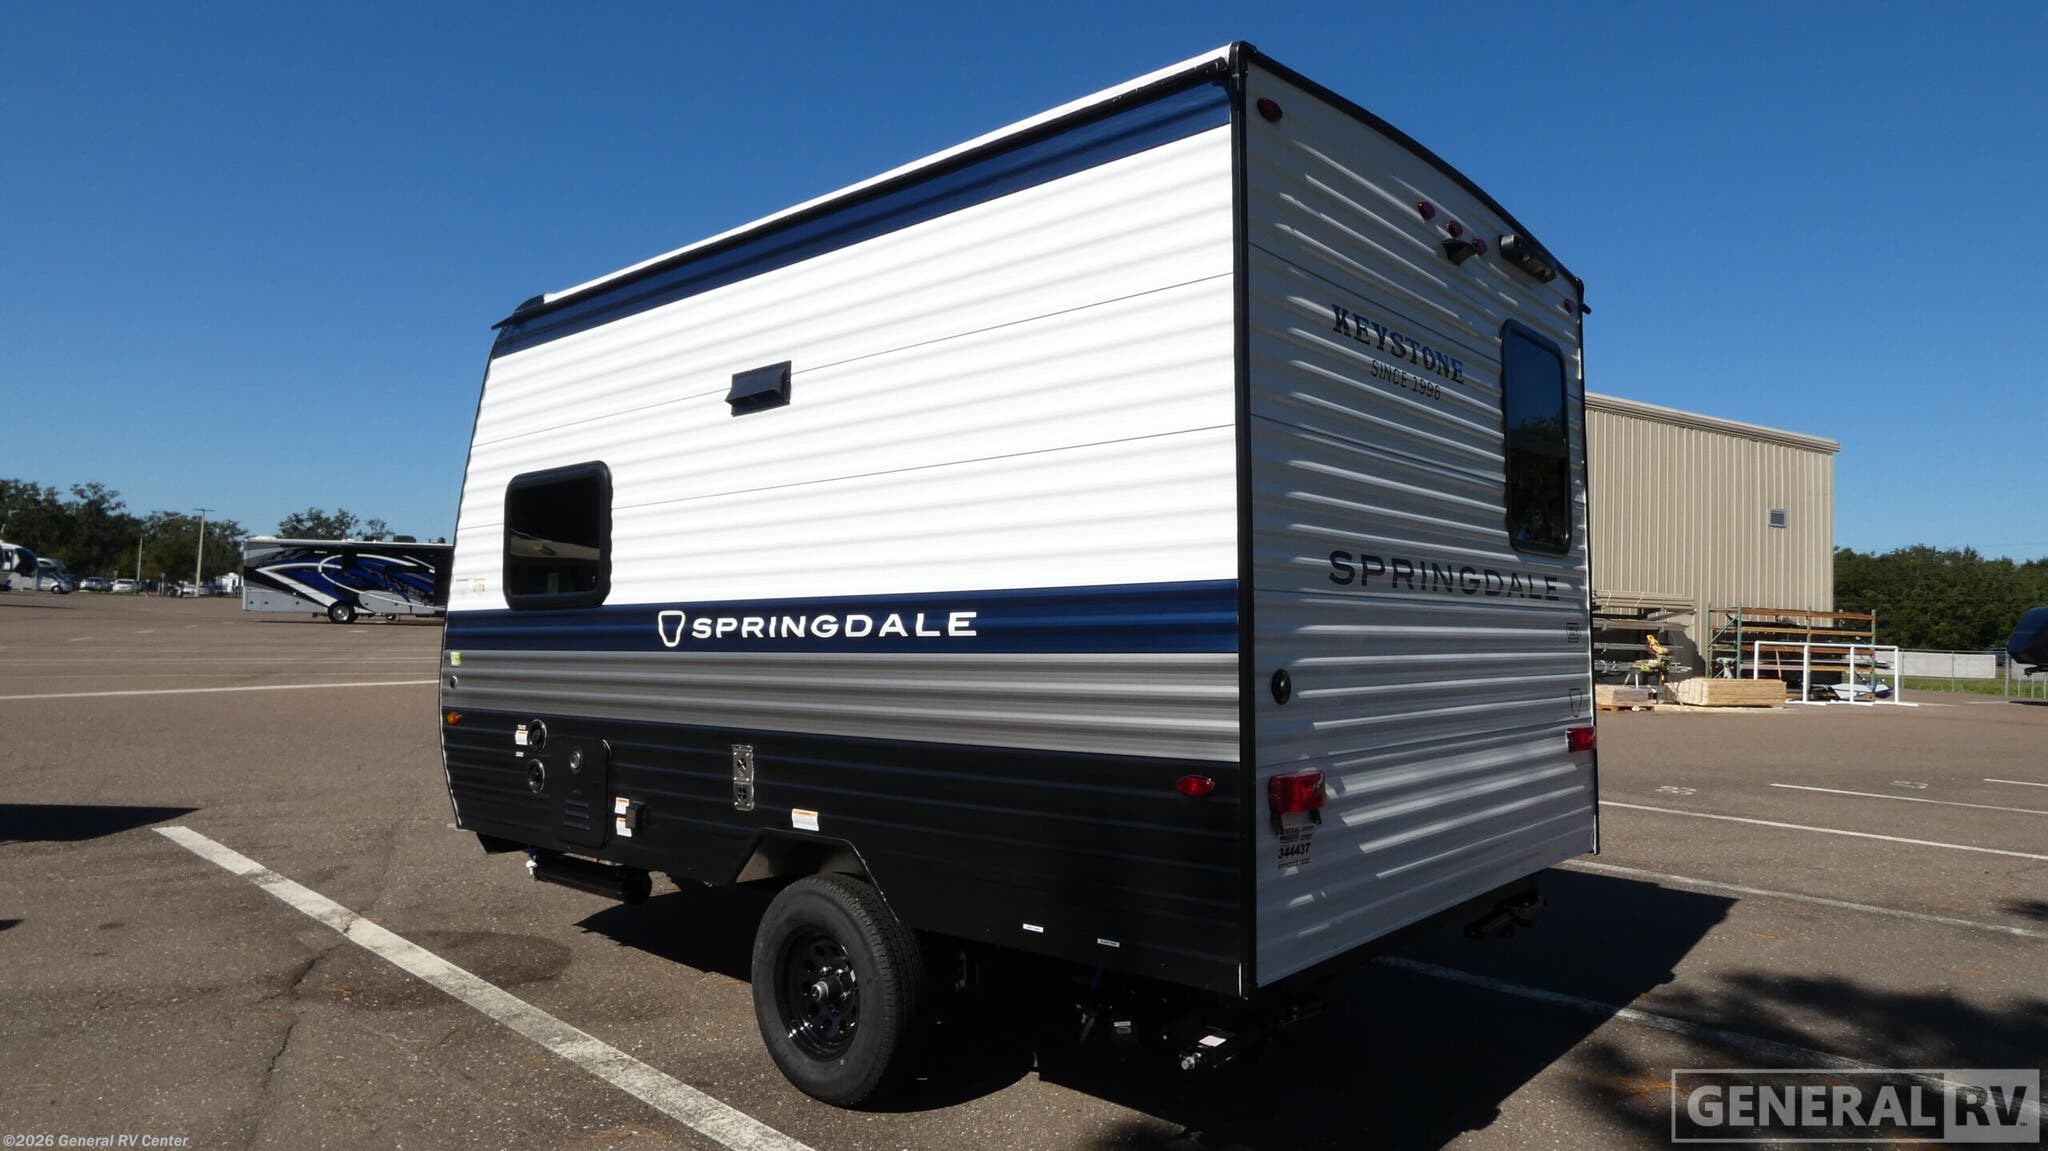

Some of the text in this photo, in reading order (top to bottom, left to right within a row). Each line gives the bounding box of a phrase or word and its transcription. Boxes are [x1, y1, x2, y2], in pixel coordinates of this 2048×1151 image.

[1331, 304, 1465, 384] KEYSTONE
[1371, 360, 1441, 400] SINCE 1996
[1329, 550, 1560, 600] SPRINGDALE
[692, 611, 977, 639] SPRINGDALE
